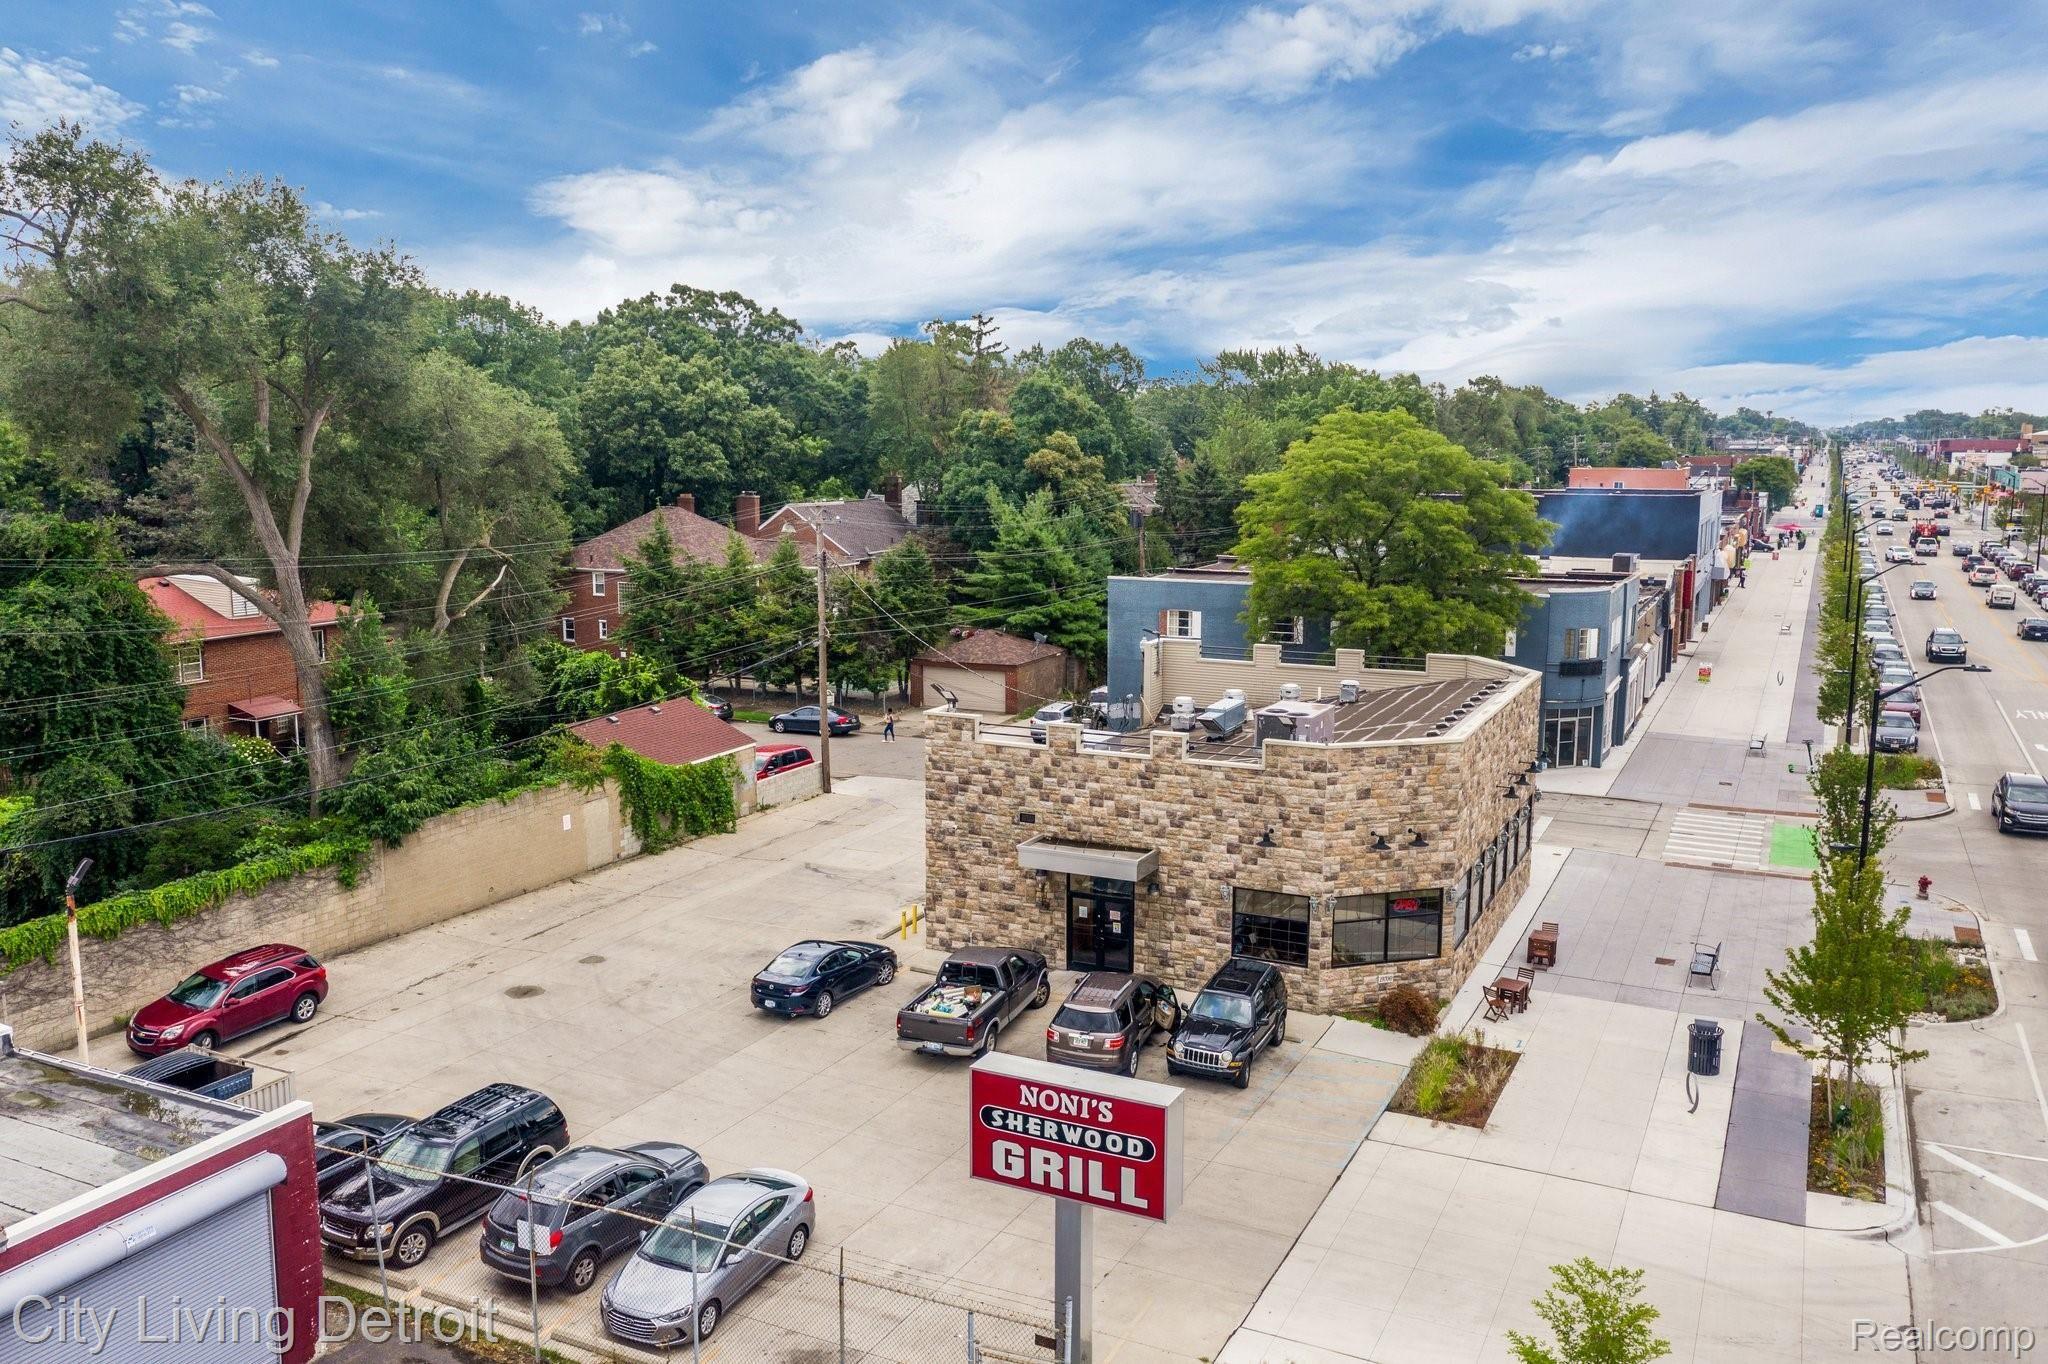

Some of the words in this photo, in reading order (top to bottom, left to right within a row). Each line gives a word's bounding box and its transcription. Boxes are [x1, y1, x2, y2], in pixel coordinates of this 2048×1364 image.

[2015, 709, 2048, 720] NLY
[1020, 1084, 1113, 1123] NONI'S
[991, 1109, 1145, 1158] SHERWOOD
[992, 1139, 1149, 1209] GRILL
